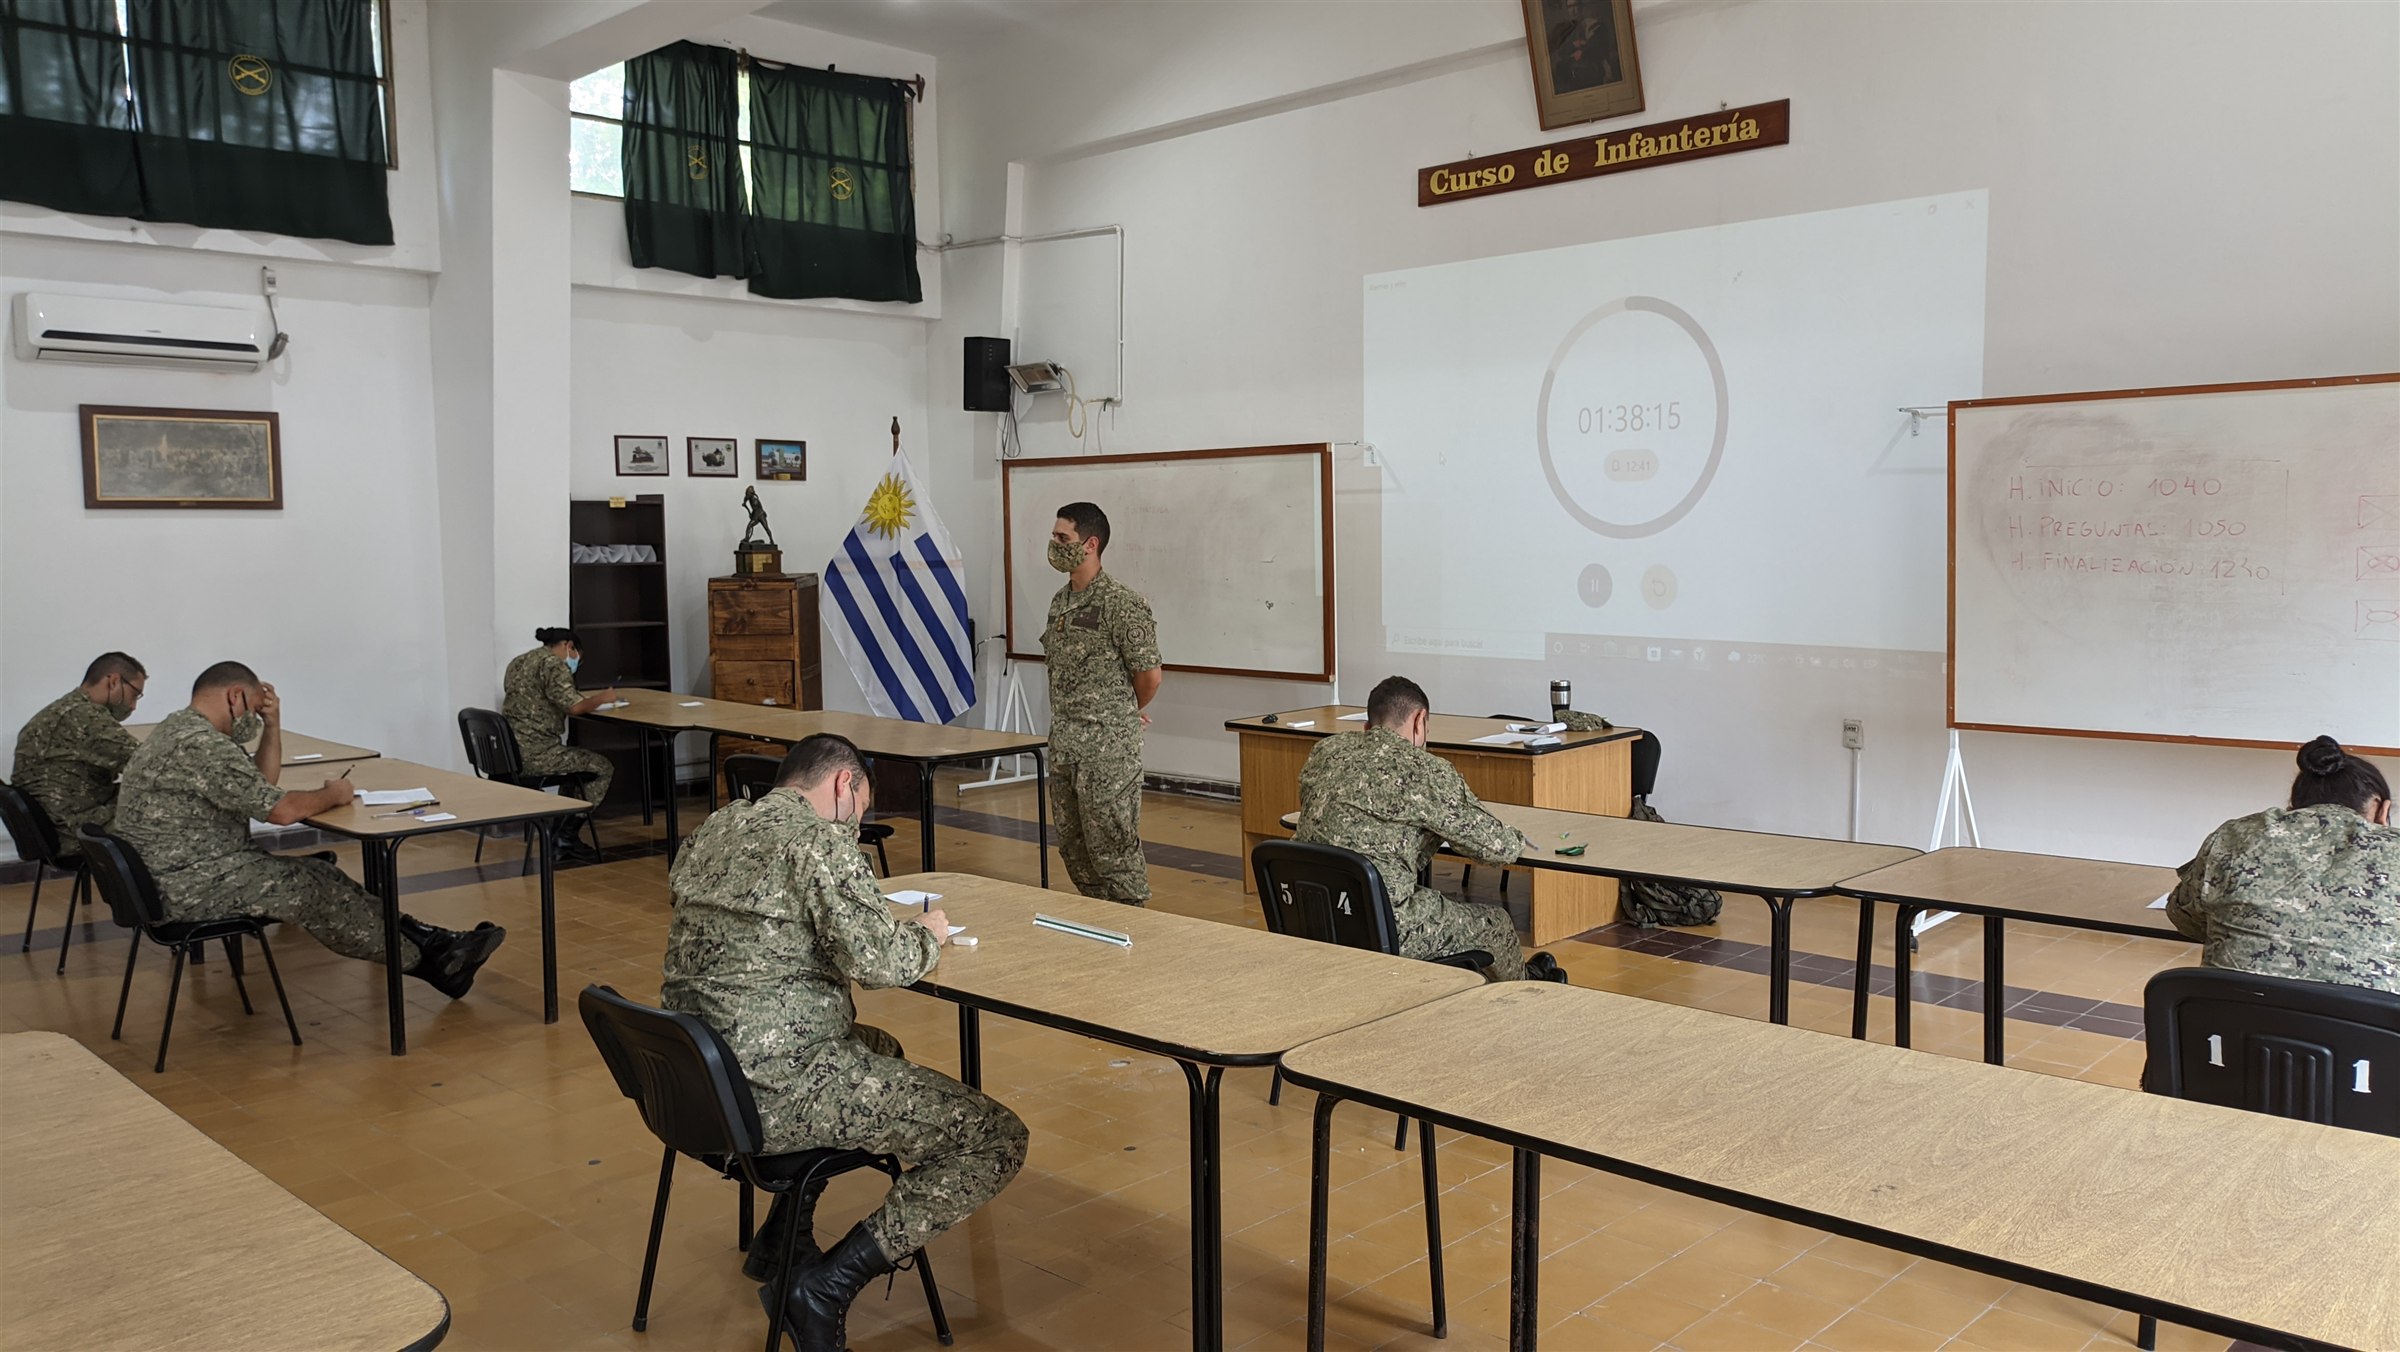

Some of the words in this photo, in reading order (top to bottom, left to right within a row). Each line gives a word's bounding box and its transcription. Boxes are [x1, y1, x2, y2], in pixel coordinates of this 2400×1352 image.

[1429, 162, 1516, 195] Curso
[1533, 151, 1569, 178] de
[1594, 112, 1760, 167] Infantería
[1578, 401, 1681, 434] 01:38:15
[2009, 476, 2032, 500] H.
[2148, 476, 2222, 496] 1040
[2008, 515, 2032, 538] H.
[2184, 518, 2247, 537] 1050
[1280, 882, 1293, 905] 5
[1337, 891, 1352, 915] 4
[2207, 1034, 2225, 1067] 1
[2352, 1059, 2372, 1093] 1
